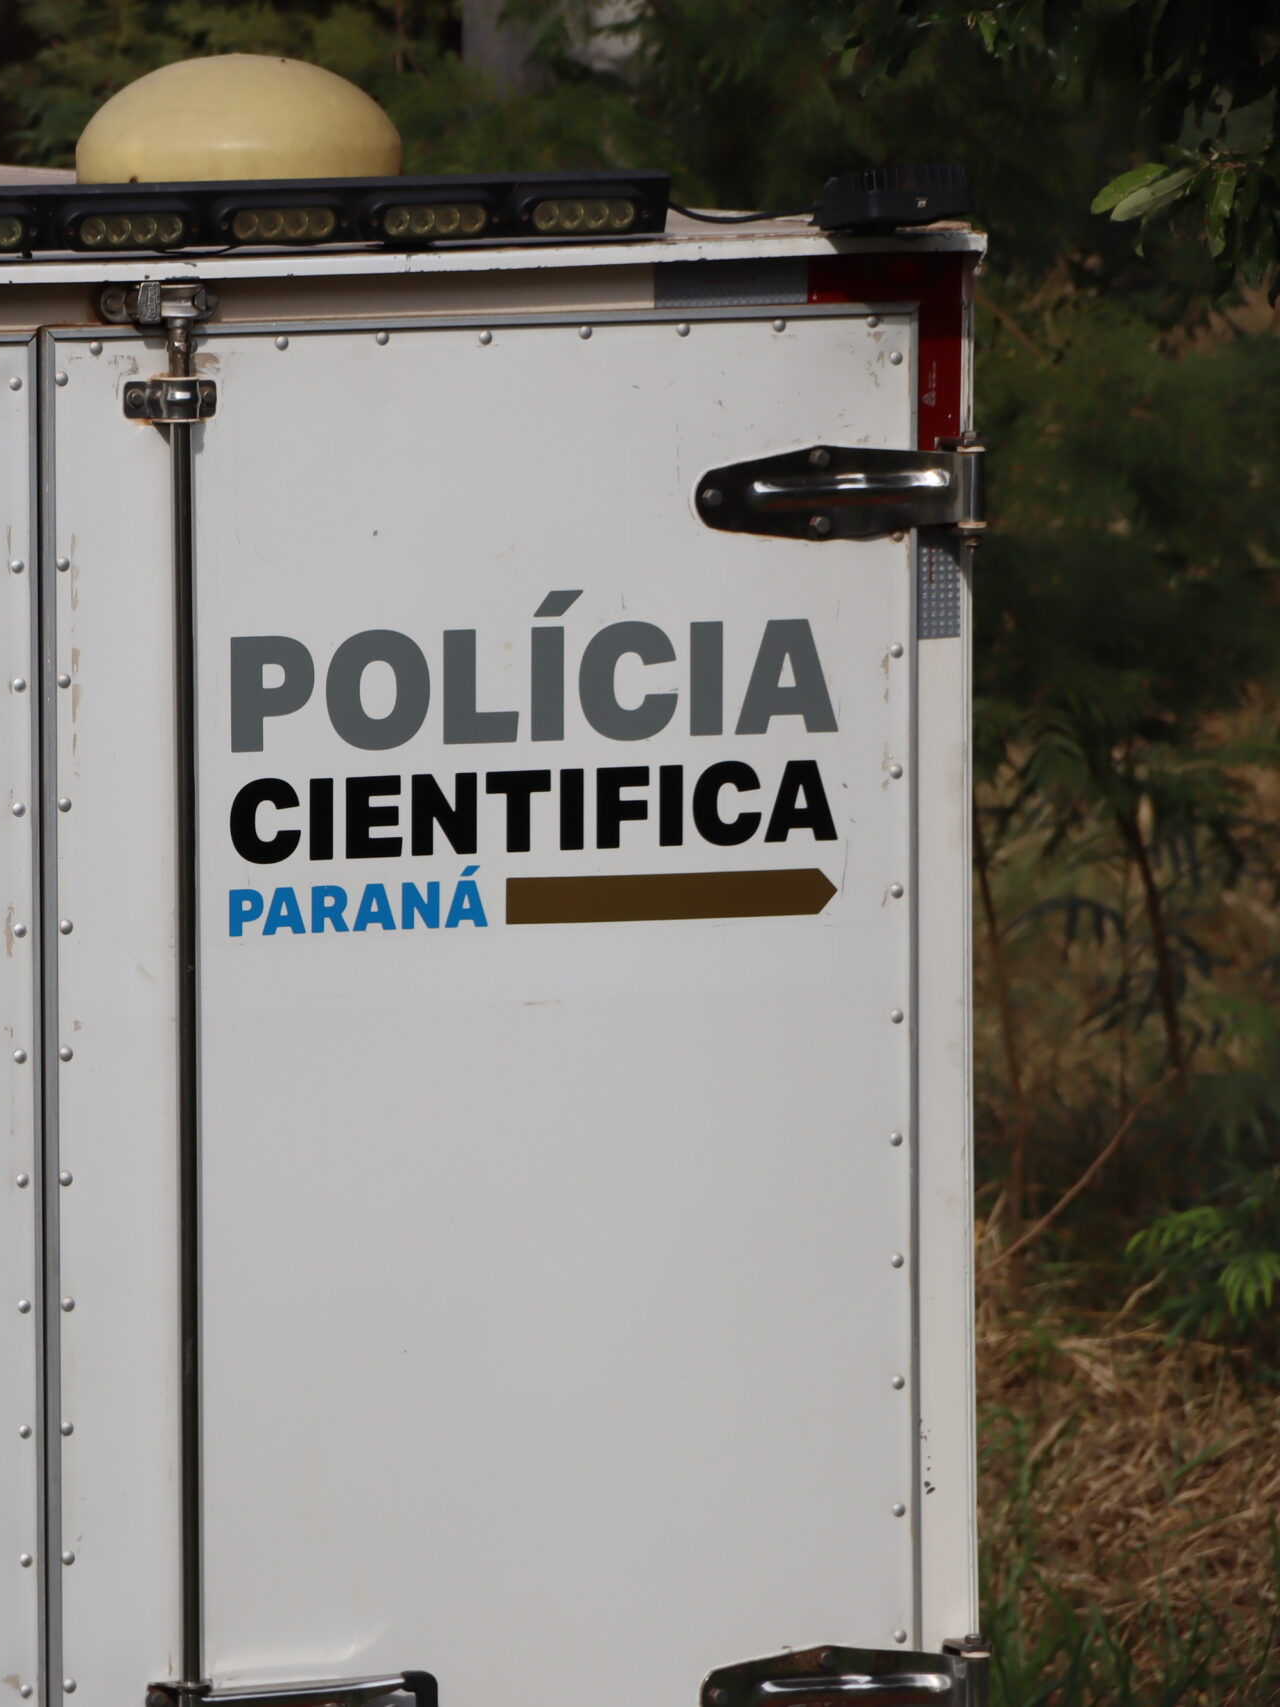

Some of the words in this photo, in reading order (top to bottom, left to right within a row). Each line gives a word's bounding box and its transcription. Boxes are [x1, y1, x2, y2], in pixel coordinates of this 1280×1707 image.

[230, 589, 839, 753] POLÍCIA
[229, 759, 839, 865] CIENTIFICA
[228, 865, 489, 938] PARANÁ
